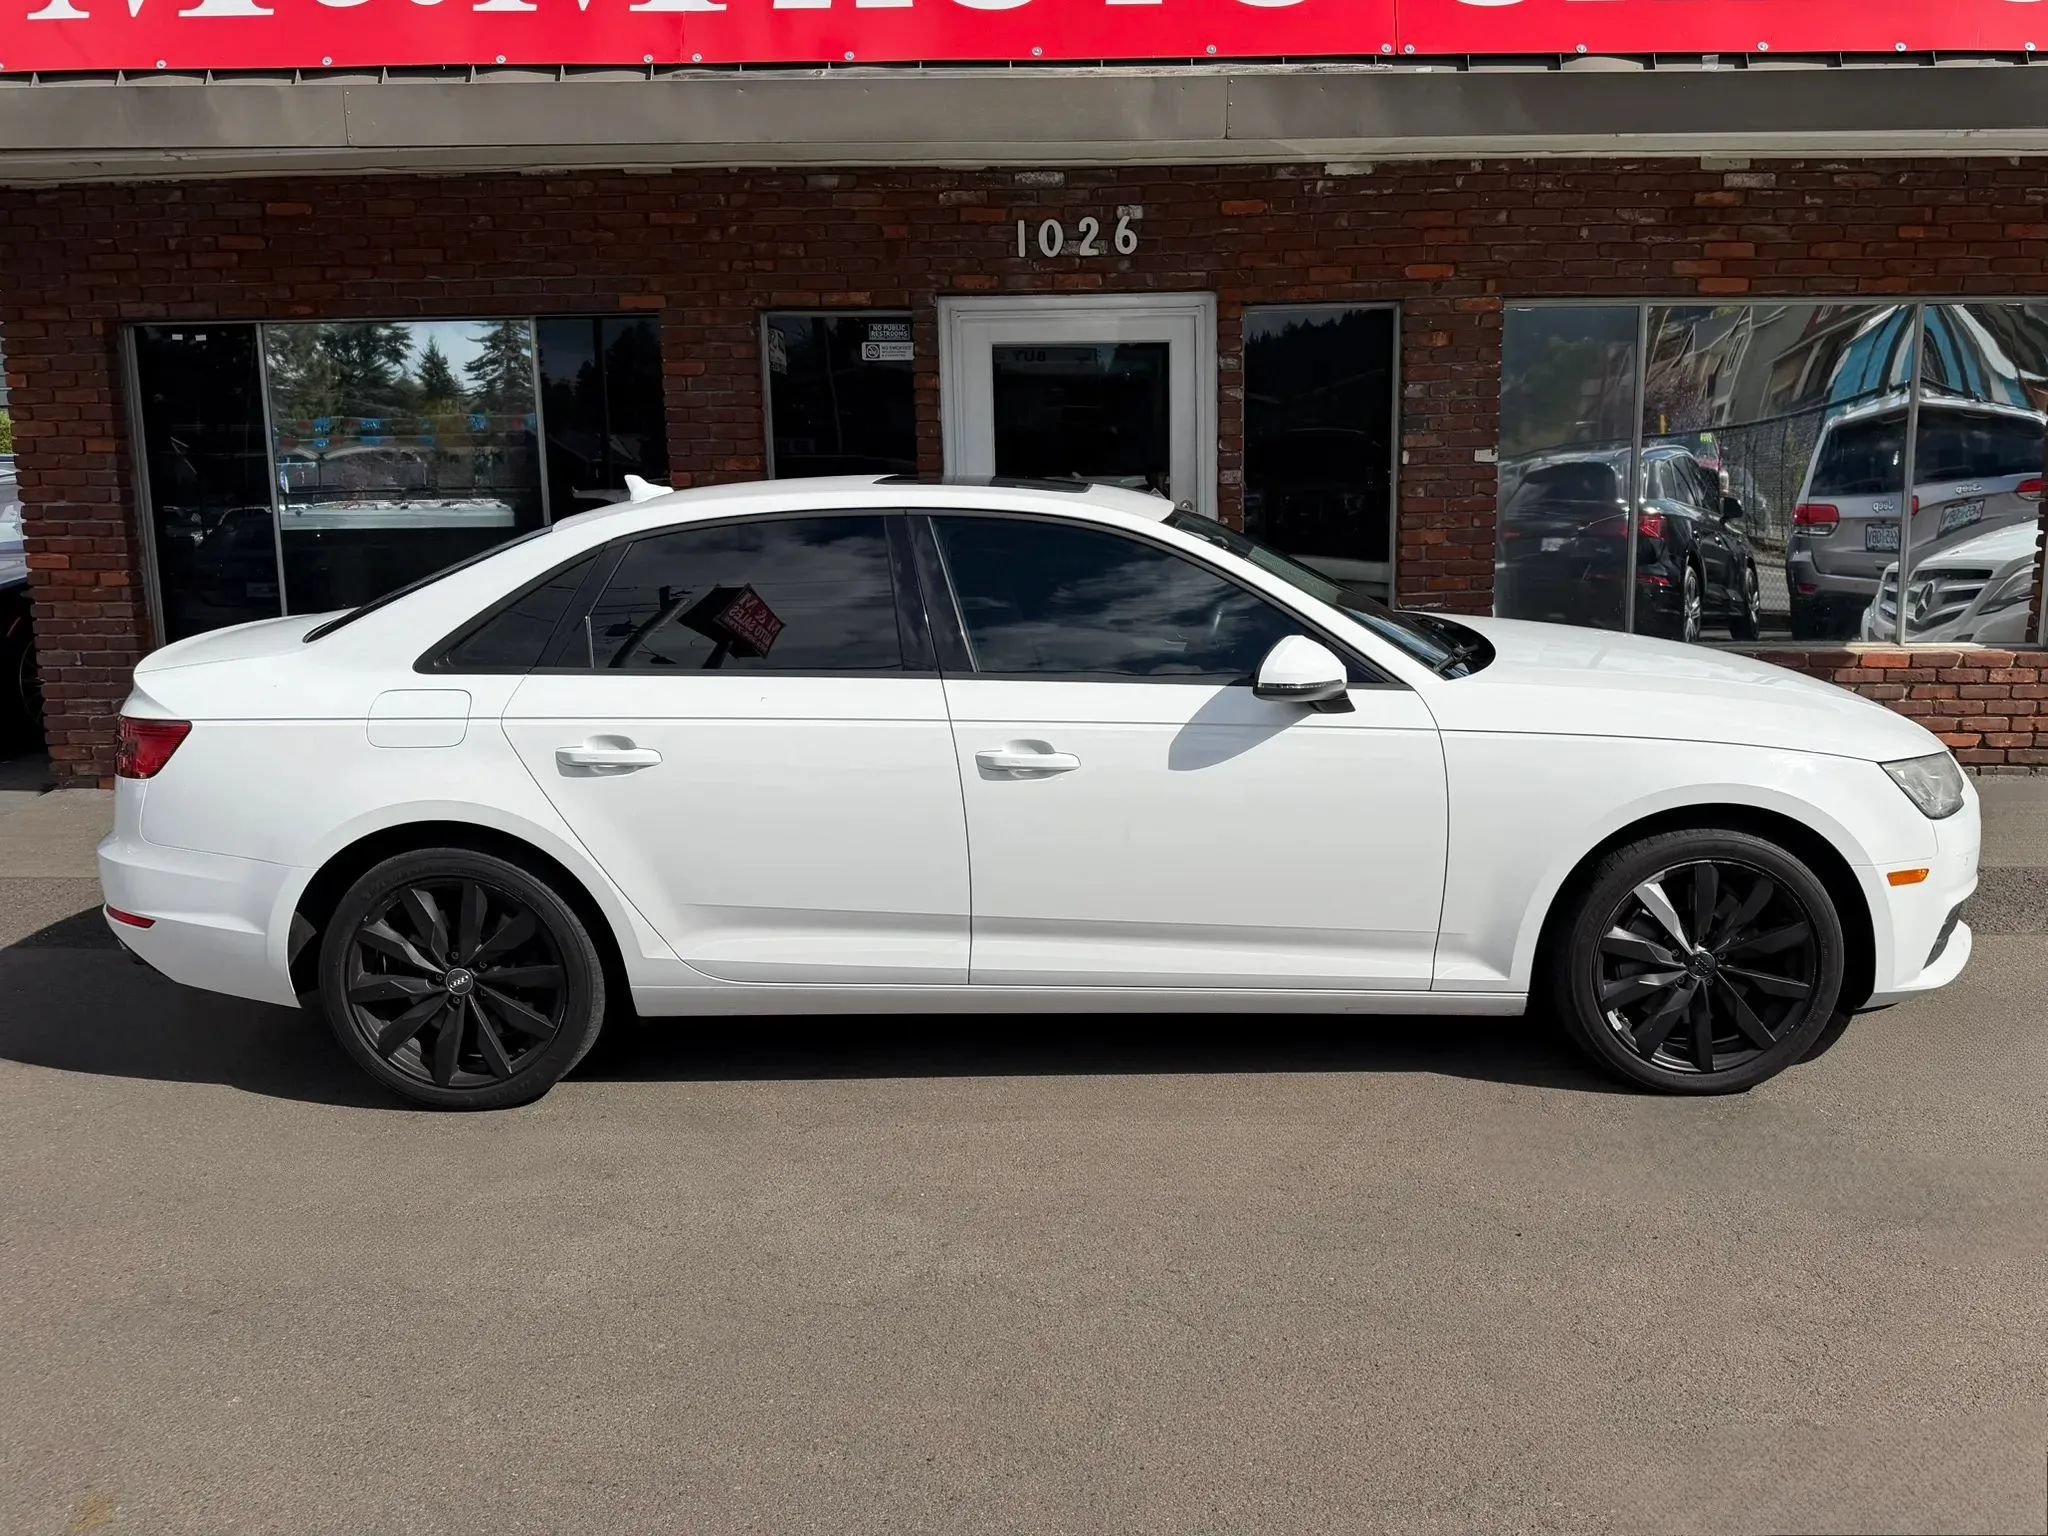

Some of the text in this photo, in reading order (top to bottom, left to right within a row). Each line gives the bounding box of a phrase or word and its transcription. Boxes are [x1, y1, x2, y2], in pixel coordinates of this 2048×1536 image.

[1017, 215, 1138, 258] 1026
[872, 323, 906, 331] NO PUBLIC
